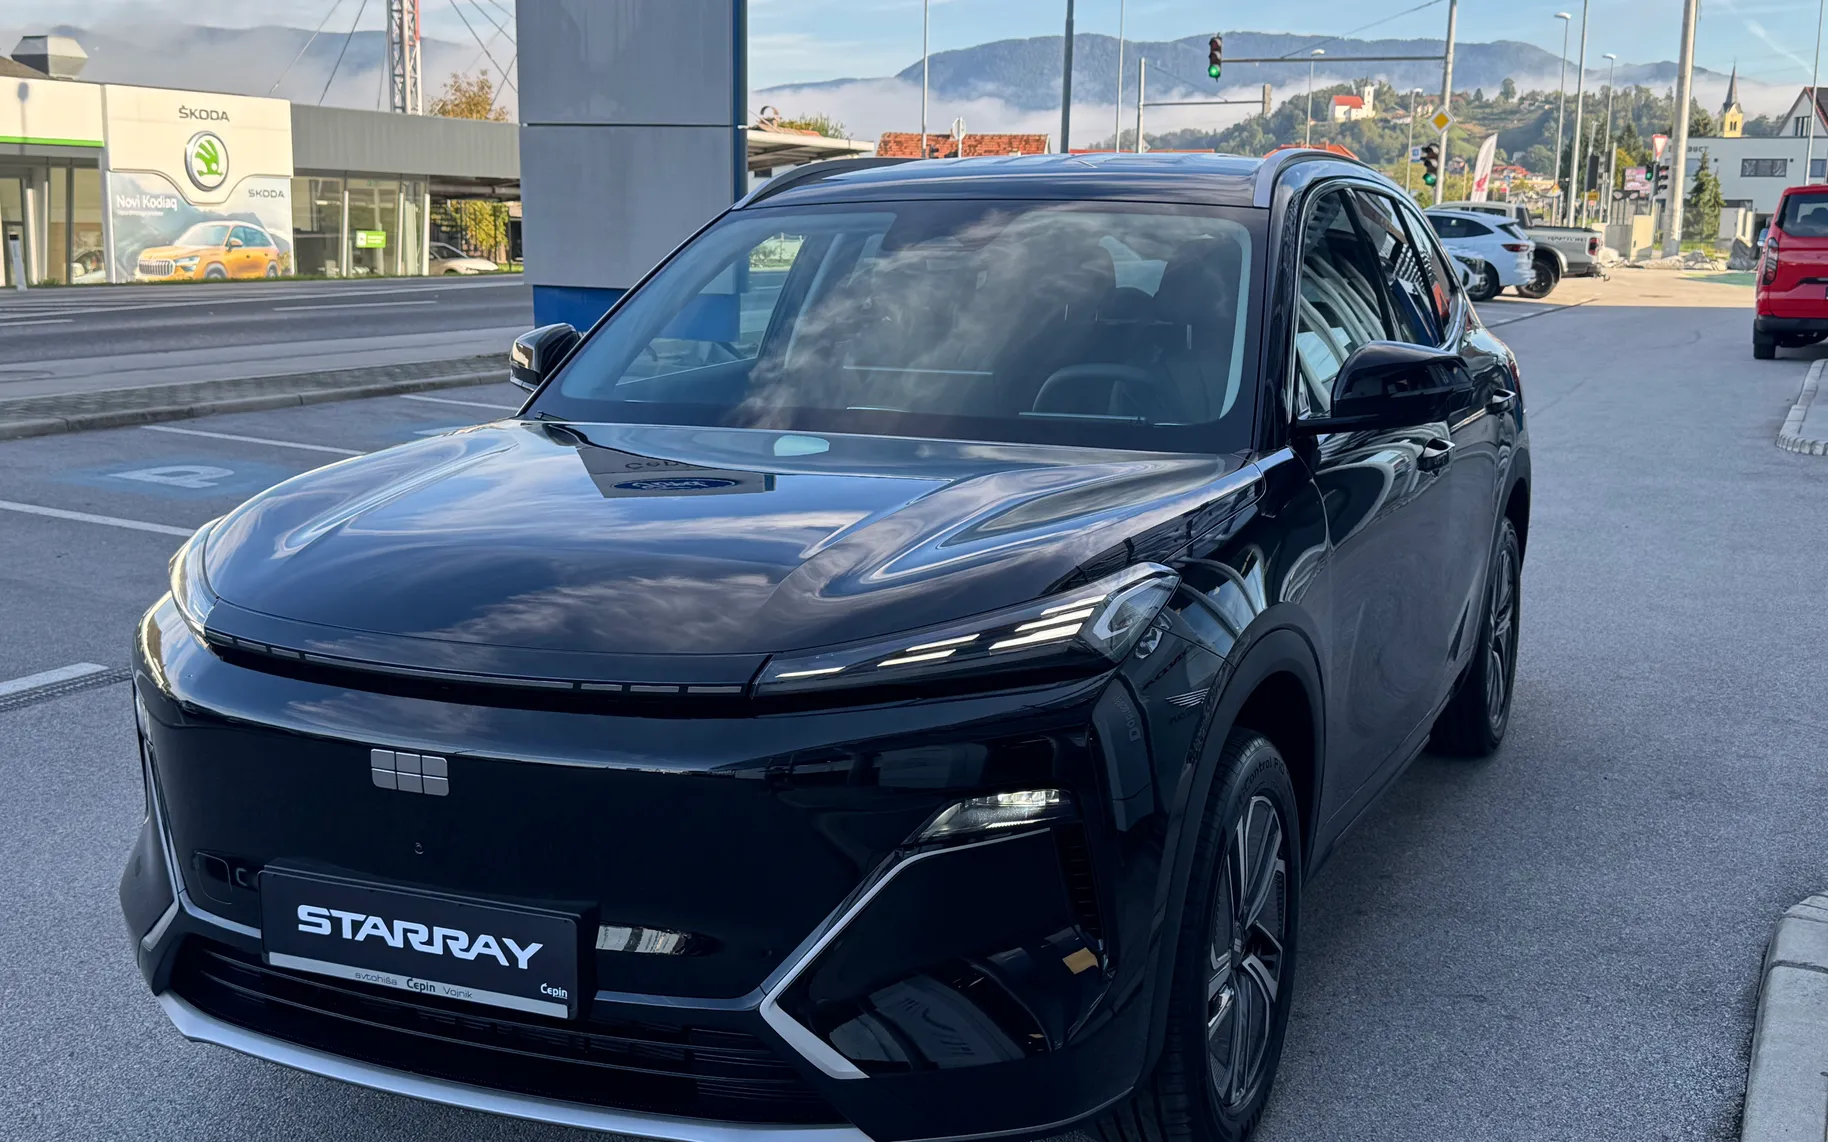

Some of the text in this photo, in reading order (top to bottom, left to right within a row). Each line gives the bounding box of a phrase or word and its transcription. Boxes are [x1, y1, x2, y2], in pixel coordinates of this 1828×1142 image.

[178, 105, 230, 122] ŠKODA
[116, 195, 178, 211] Novi Kodiaq
[297, 904, 543, 970] STARRAY
[355, 972, 398, 986] avtohiša
[443, 986, 473, 999] Vojnik
